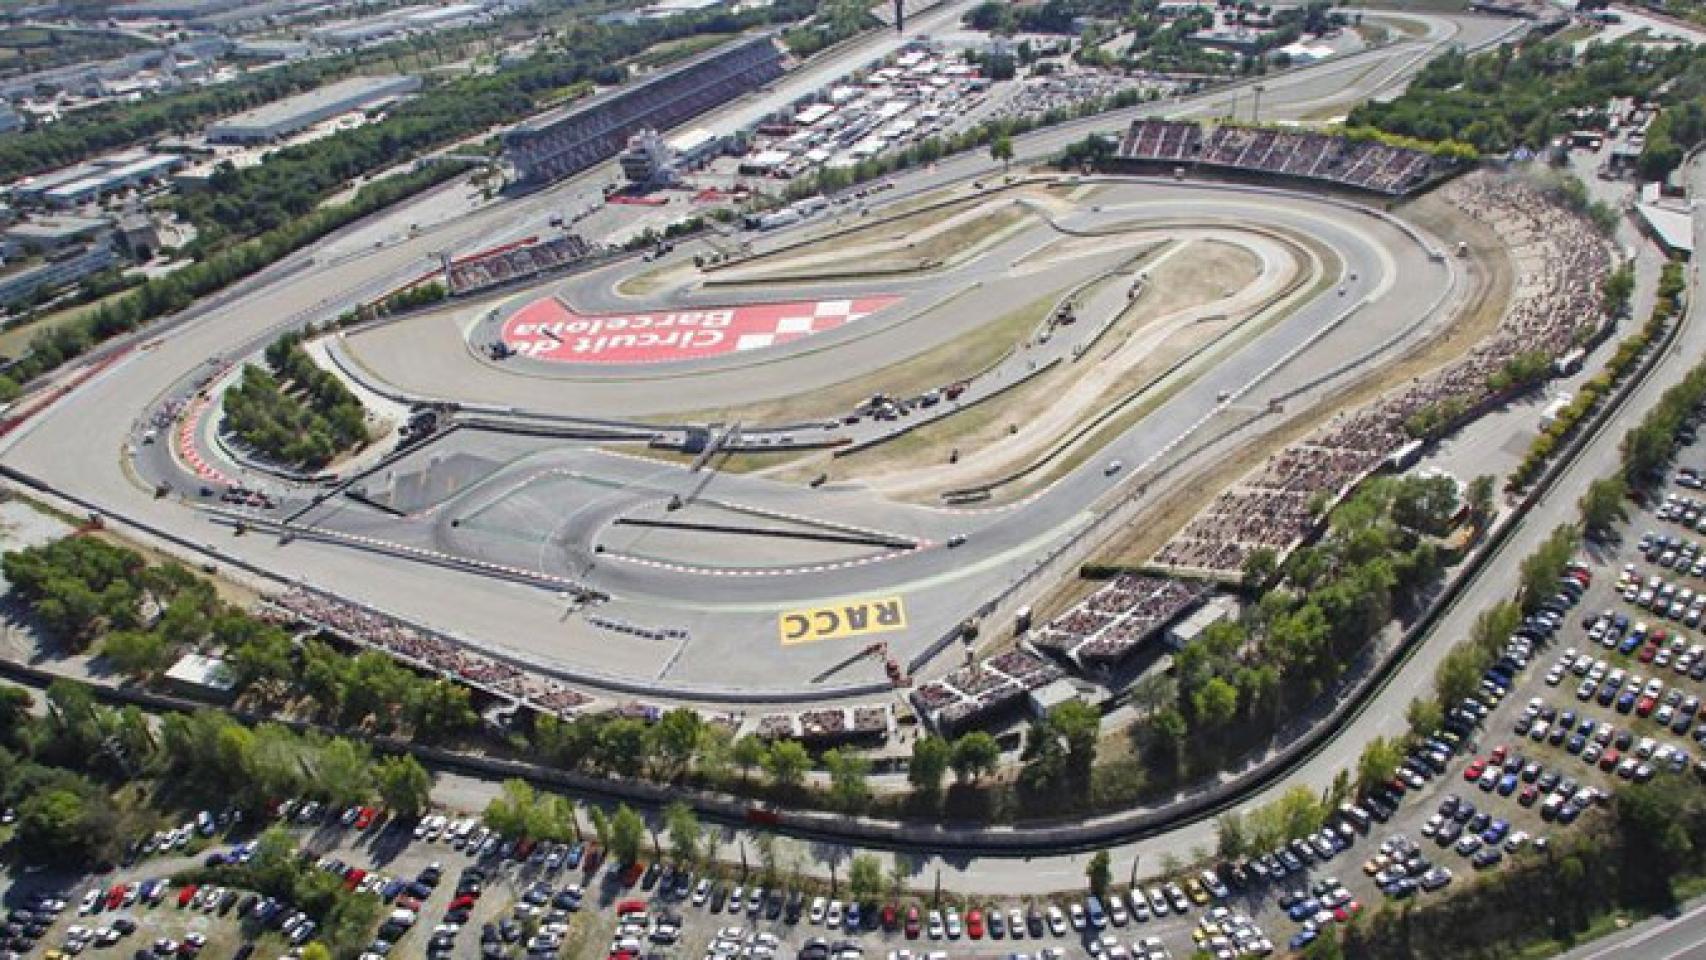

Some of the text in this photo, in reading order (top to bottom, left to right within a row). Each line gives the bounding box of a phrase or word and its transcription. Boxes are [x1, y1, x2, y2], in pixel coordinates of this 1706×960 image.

[513, 309, 736, 337] Barcelona
[572, 328, 725, 354] Circuit
[785, 601, 901, 638] RACC
